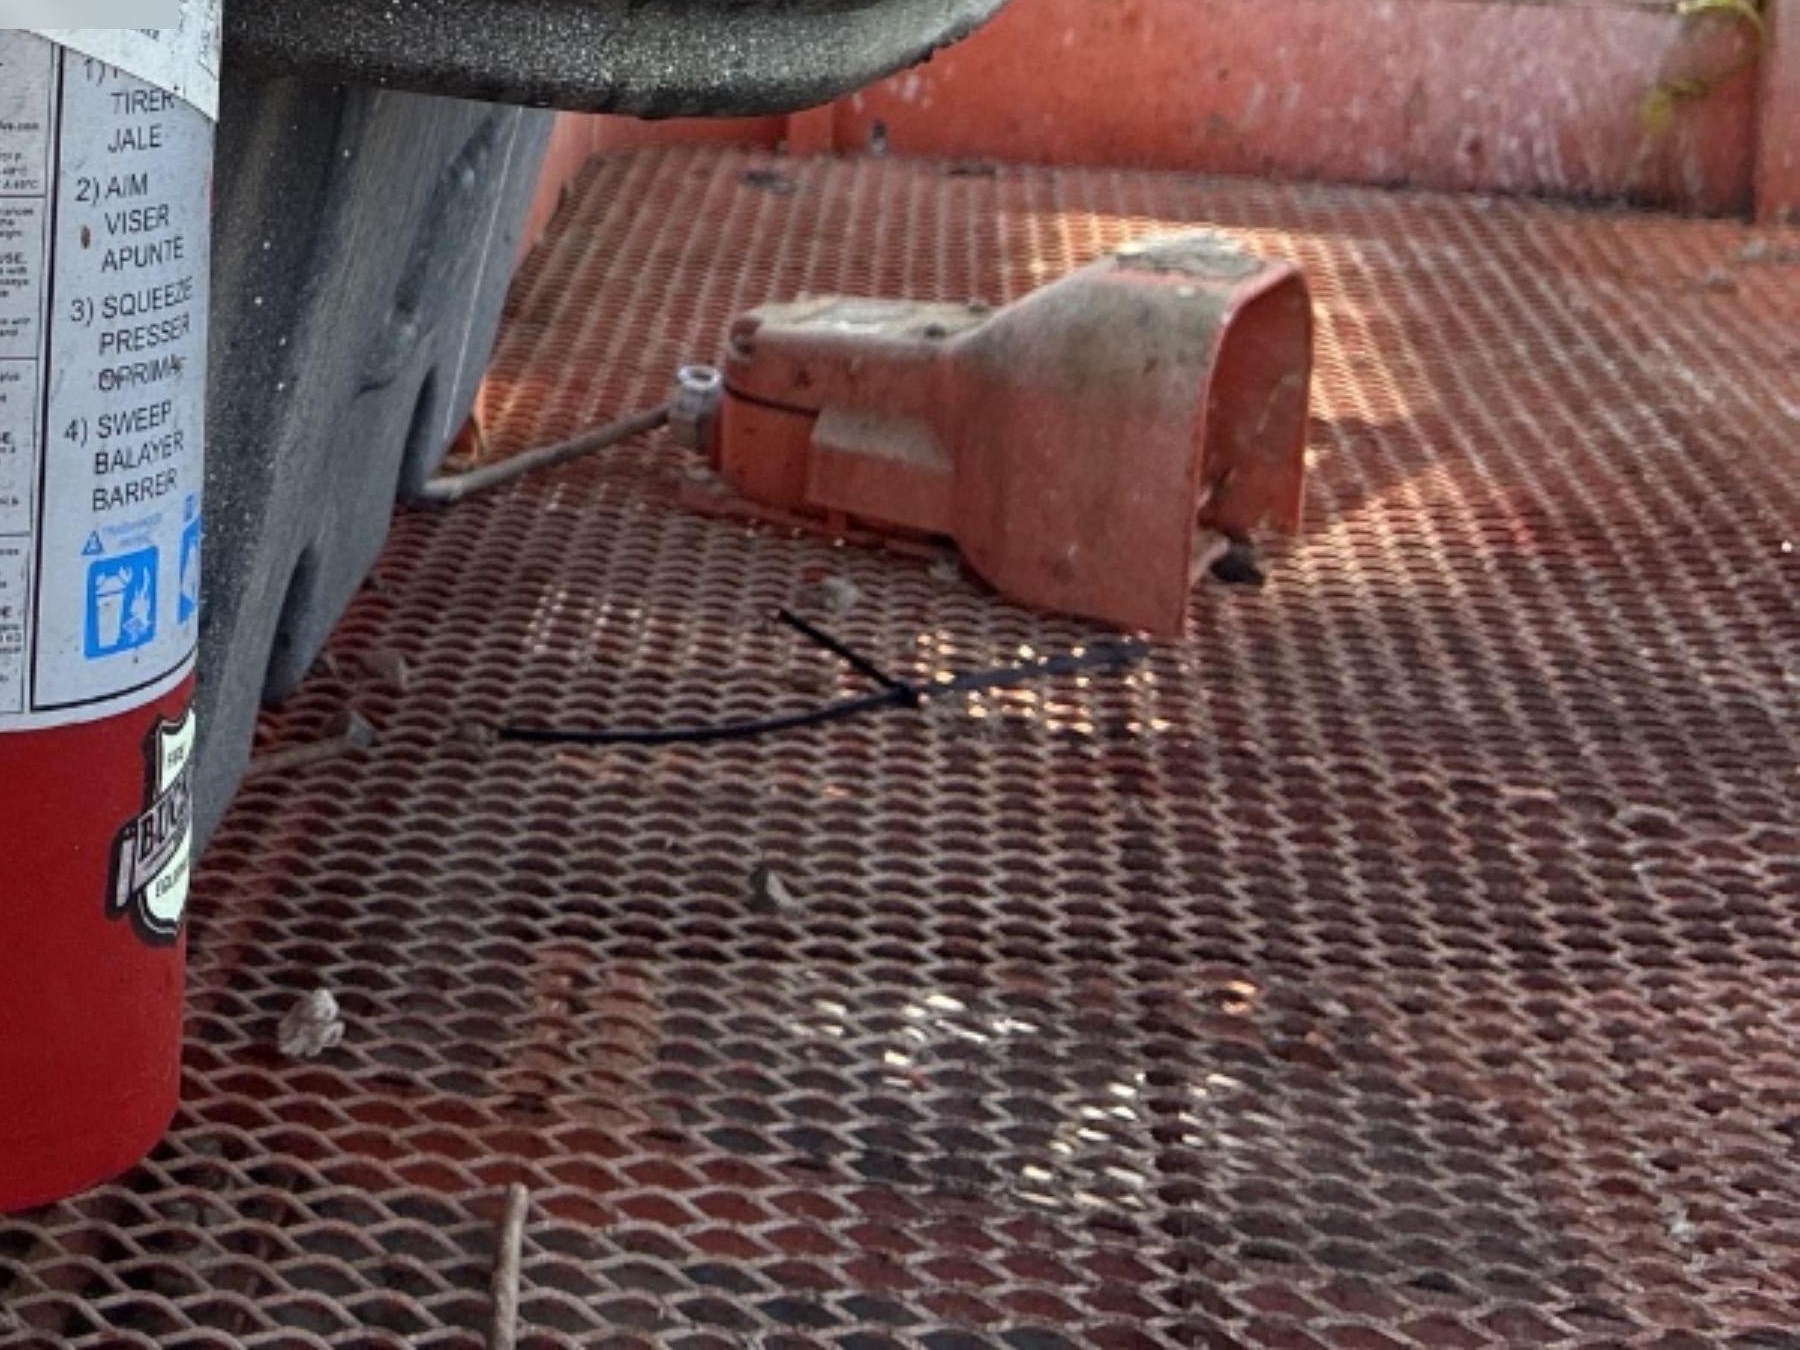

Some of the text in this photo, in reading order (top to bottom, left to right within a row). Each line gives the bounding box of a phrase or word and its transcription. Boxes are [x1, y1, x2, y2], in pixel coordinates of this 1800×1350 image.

[110, 88, 175, 115] TIRER
[107, 123, 163, 154] JALE
[74, 170, 148, 207] 2) AIM
[104, 203, 170, 235] VISER
[101, 235, 185, 274] APUNTE
[70, 275, 193, 328] 3) SQUEEZE
[98, 311, 190, 357] PRESSER
[63, 400, 172, 448] 4) SWEEP
[93, 428, 185, 476] BALAYER
[91, 467, 178, 513] BARRER
